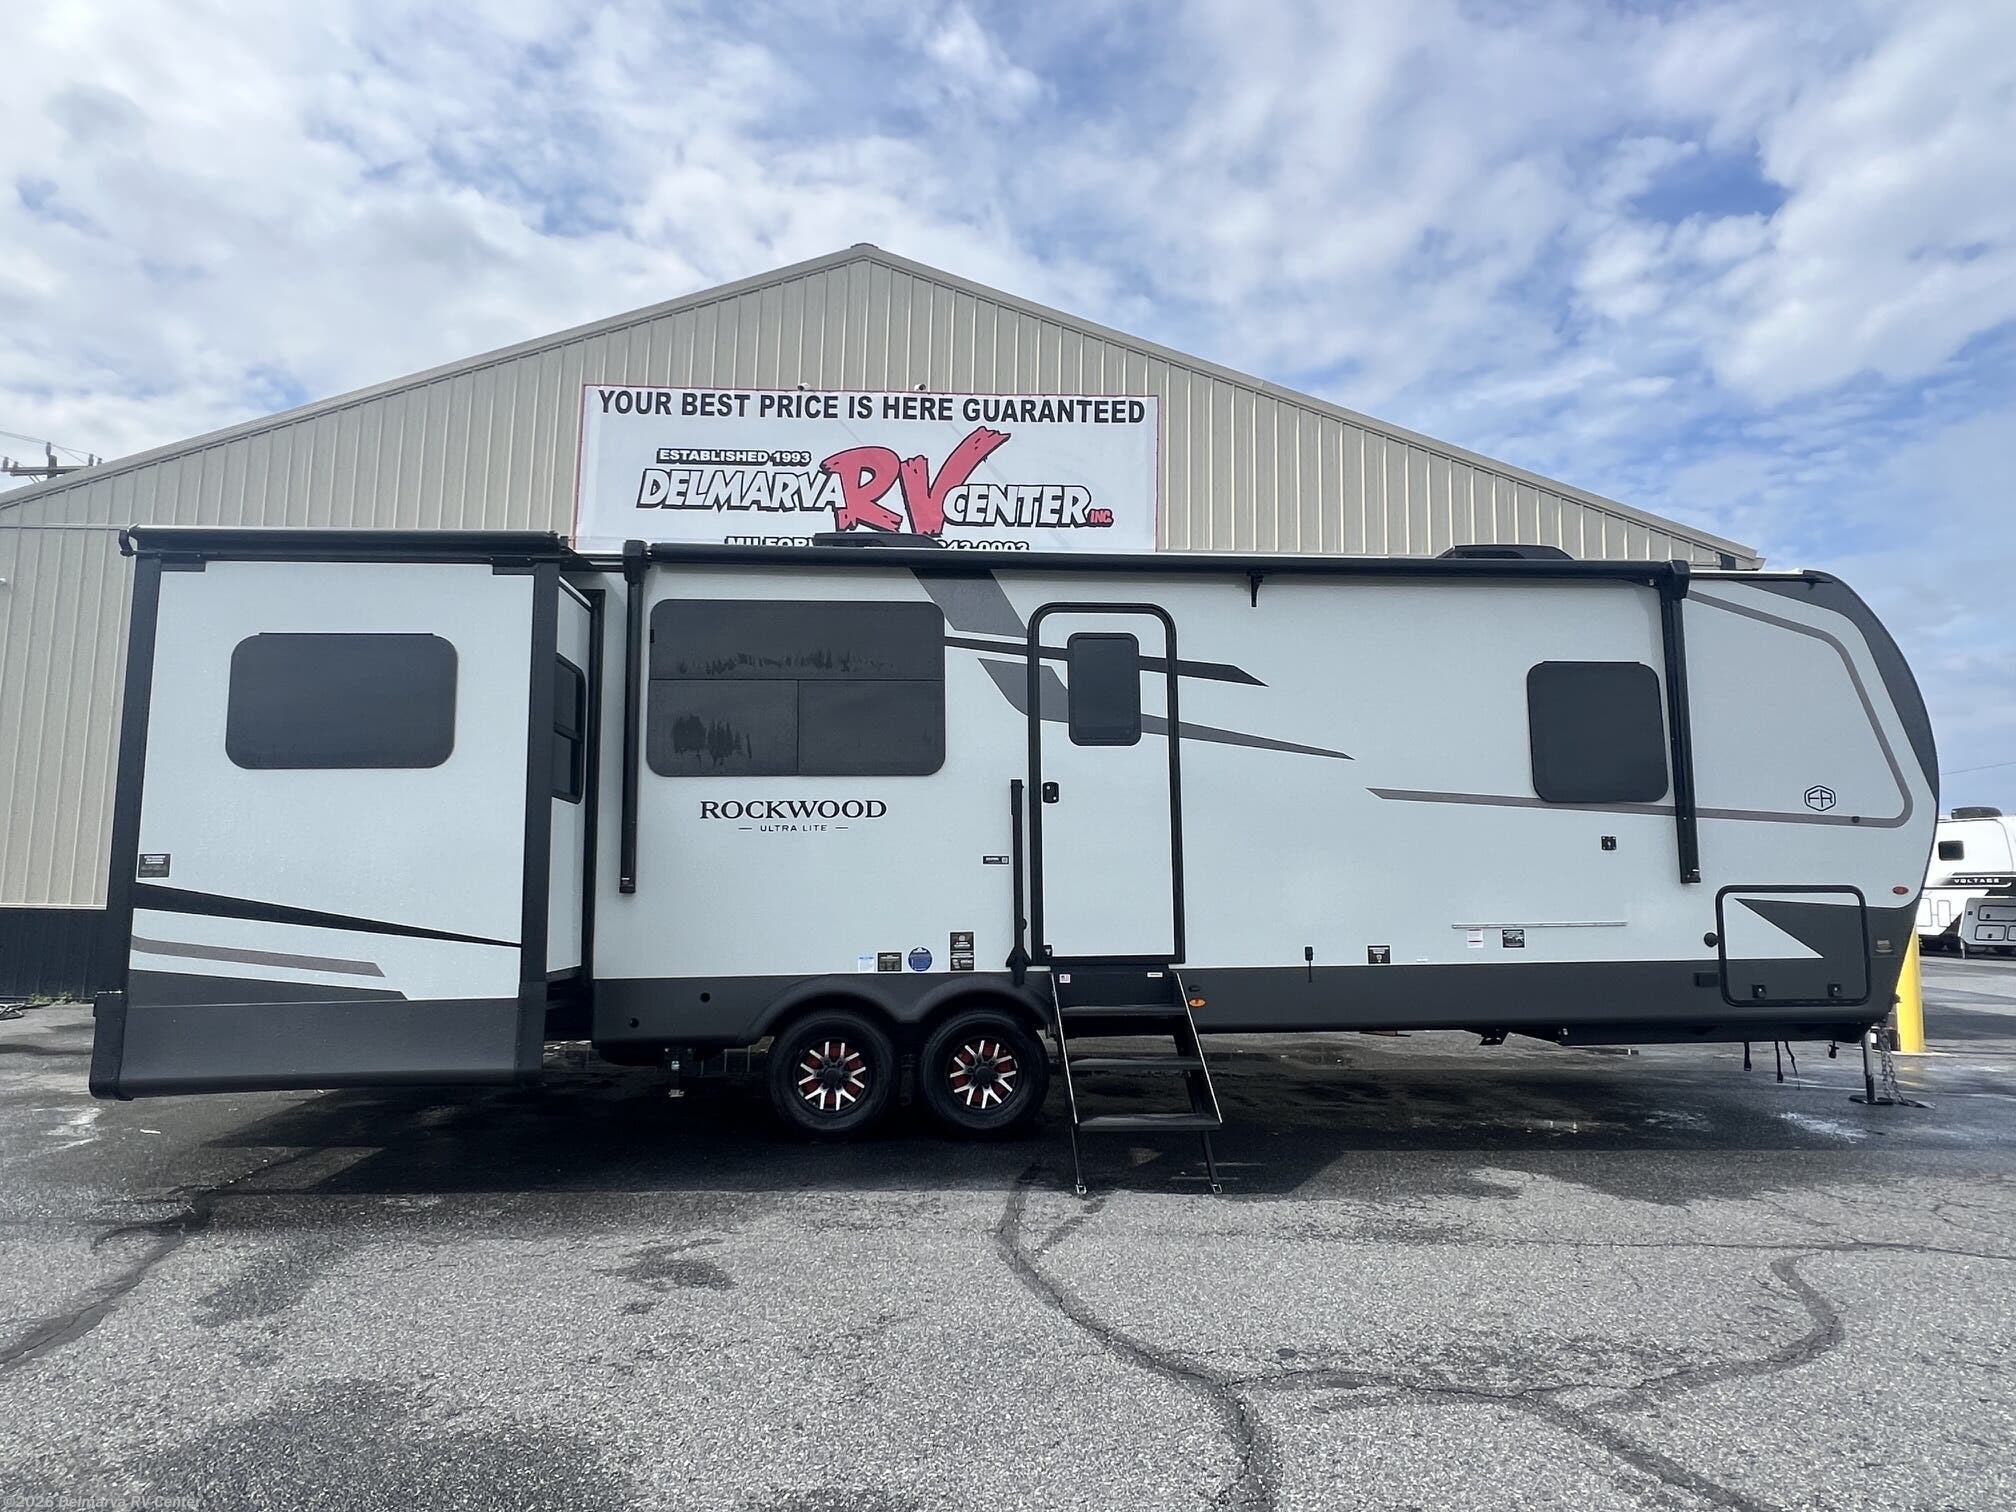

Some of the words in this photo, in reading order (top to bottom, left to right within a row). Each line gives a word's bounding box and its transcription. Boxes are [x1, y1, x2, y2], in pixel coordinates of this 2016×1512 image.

[598, 390, 672, 416] YOUR
[682, 393, 751, 418] BEST
[760, 394, 839, 419] PRICE
[849, 396, 873, 420] IS
[883, 396, 953, 421] HERE
[962, 398, 1145, 424] GUARANTEED
[657, 448, 769, 466] ESTABLISHED
[771, 450, 811, 467] 1993
[636, 468, 847, 513] DELMARVA
[819, 426, 1012, 535] RV
[942, 484, 1091, 528] CENTER
[700, 800, 887, 819] ROCKWOOD
